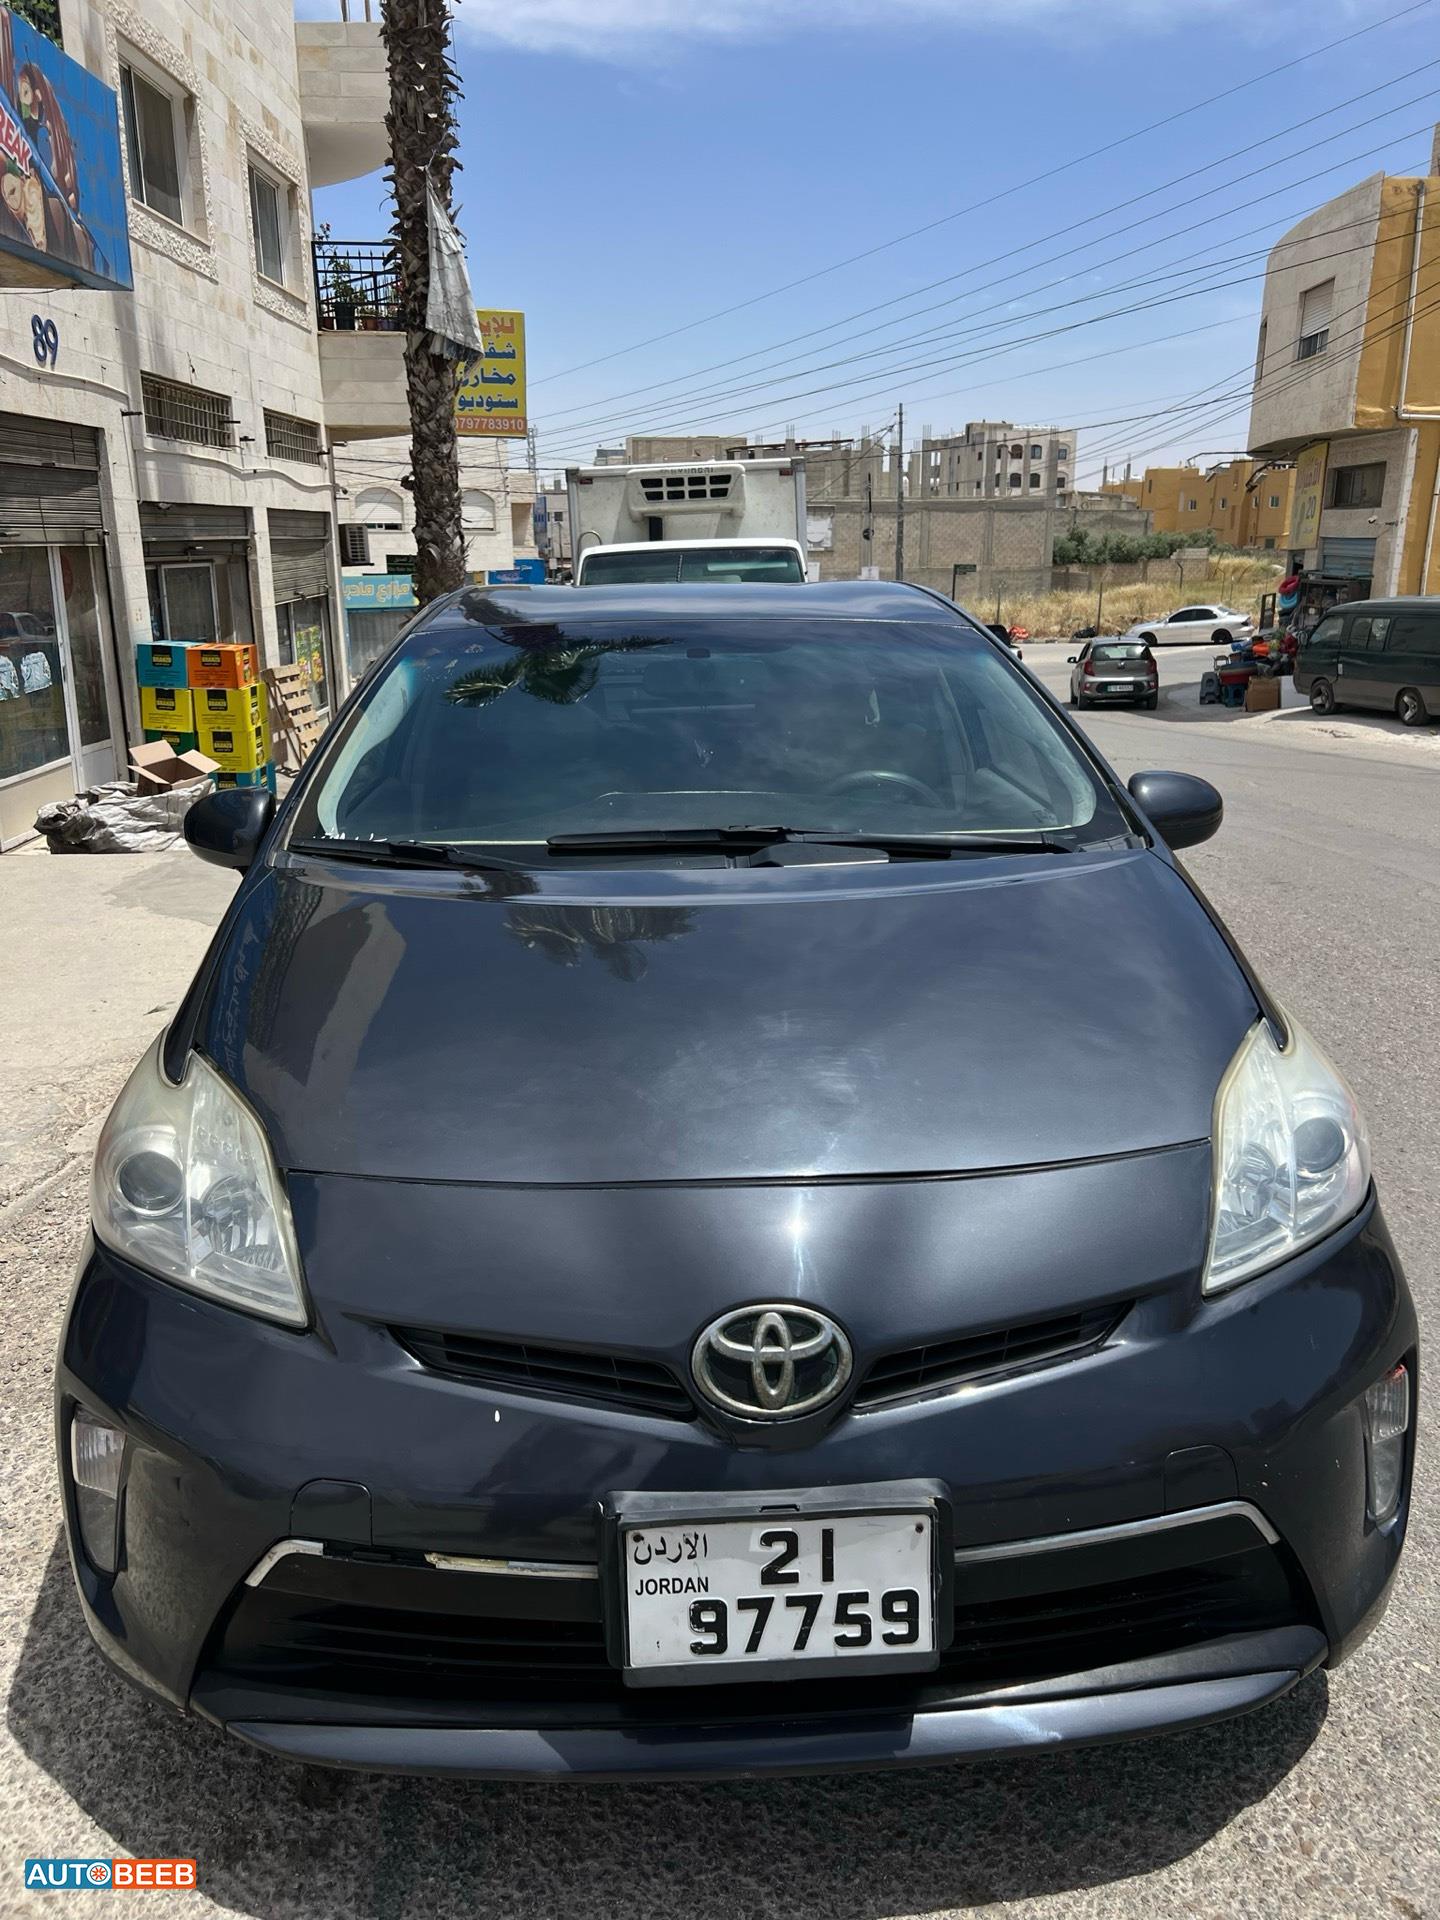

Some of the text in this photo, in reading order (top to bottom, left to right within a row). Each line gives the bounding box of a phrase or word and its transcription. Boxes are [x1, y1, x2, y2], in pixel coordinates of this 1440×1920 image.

[31, 314, 58, 366] 89
[484, 342, 517, 359] شق
[458, 394, 518, 412] ستوديو
[760, 1528, 834, 1585] 21
[635, 1576, 709, 1596] JORDAN
[688, 1586, 921, 1655] 97759
